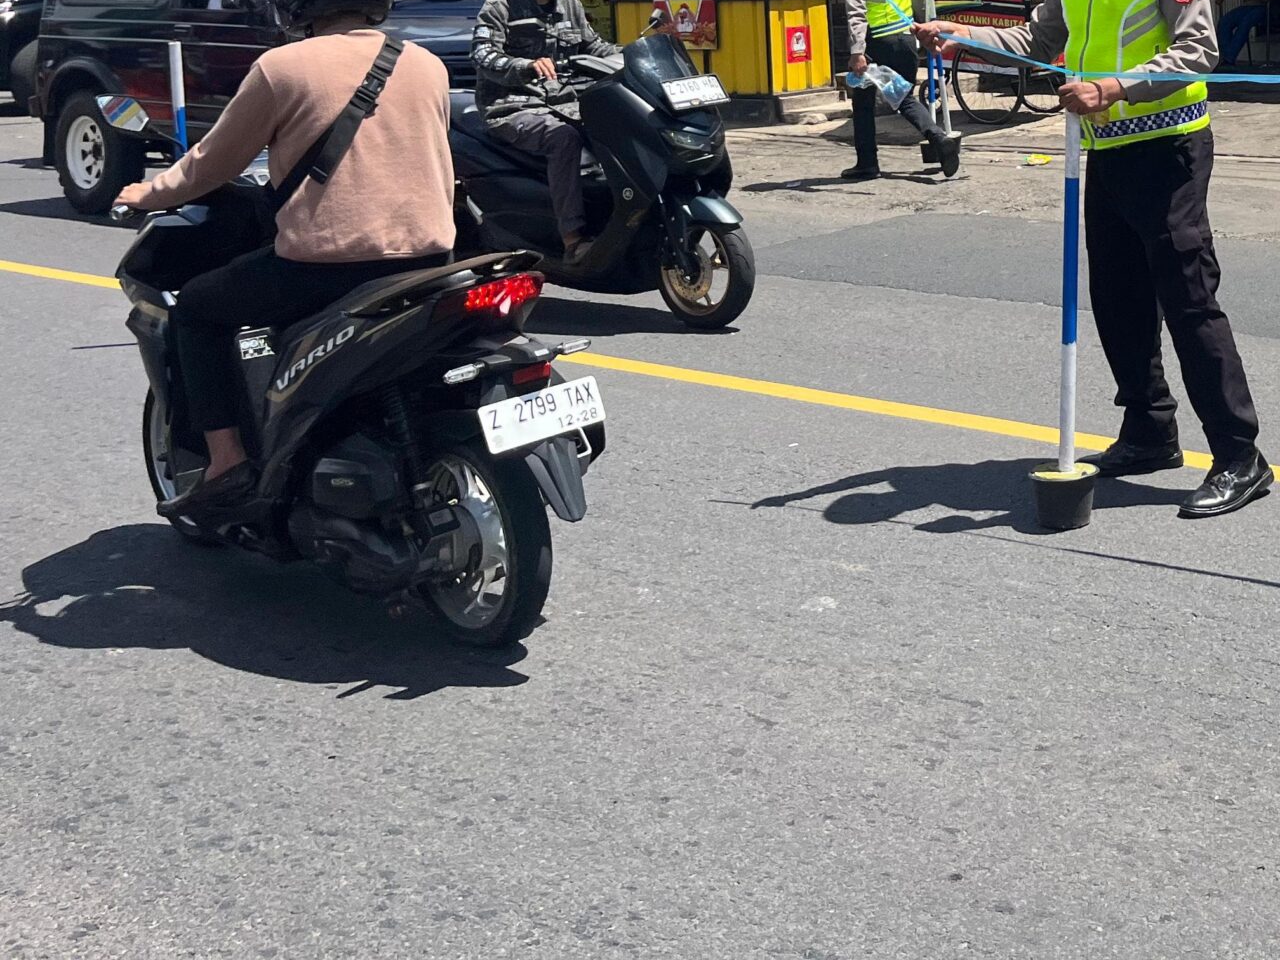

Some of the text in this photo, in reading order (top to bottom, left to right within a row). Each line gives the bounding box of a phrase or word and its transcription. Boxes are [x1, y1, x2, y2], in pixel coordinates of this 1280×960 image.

[958, 14, 990, 24] CUANKI
[992, 18, 1024, 27] KABITA
[276, 326, 355, 390] VARIO
[488, 382, 594, 430] Z 2799 TAX
